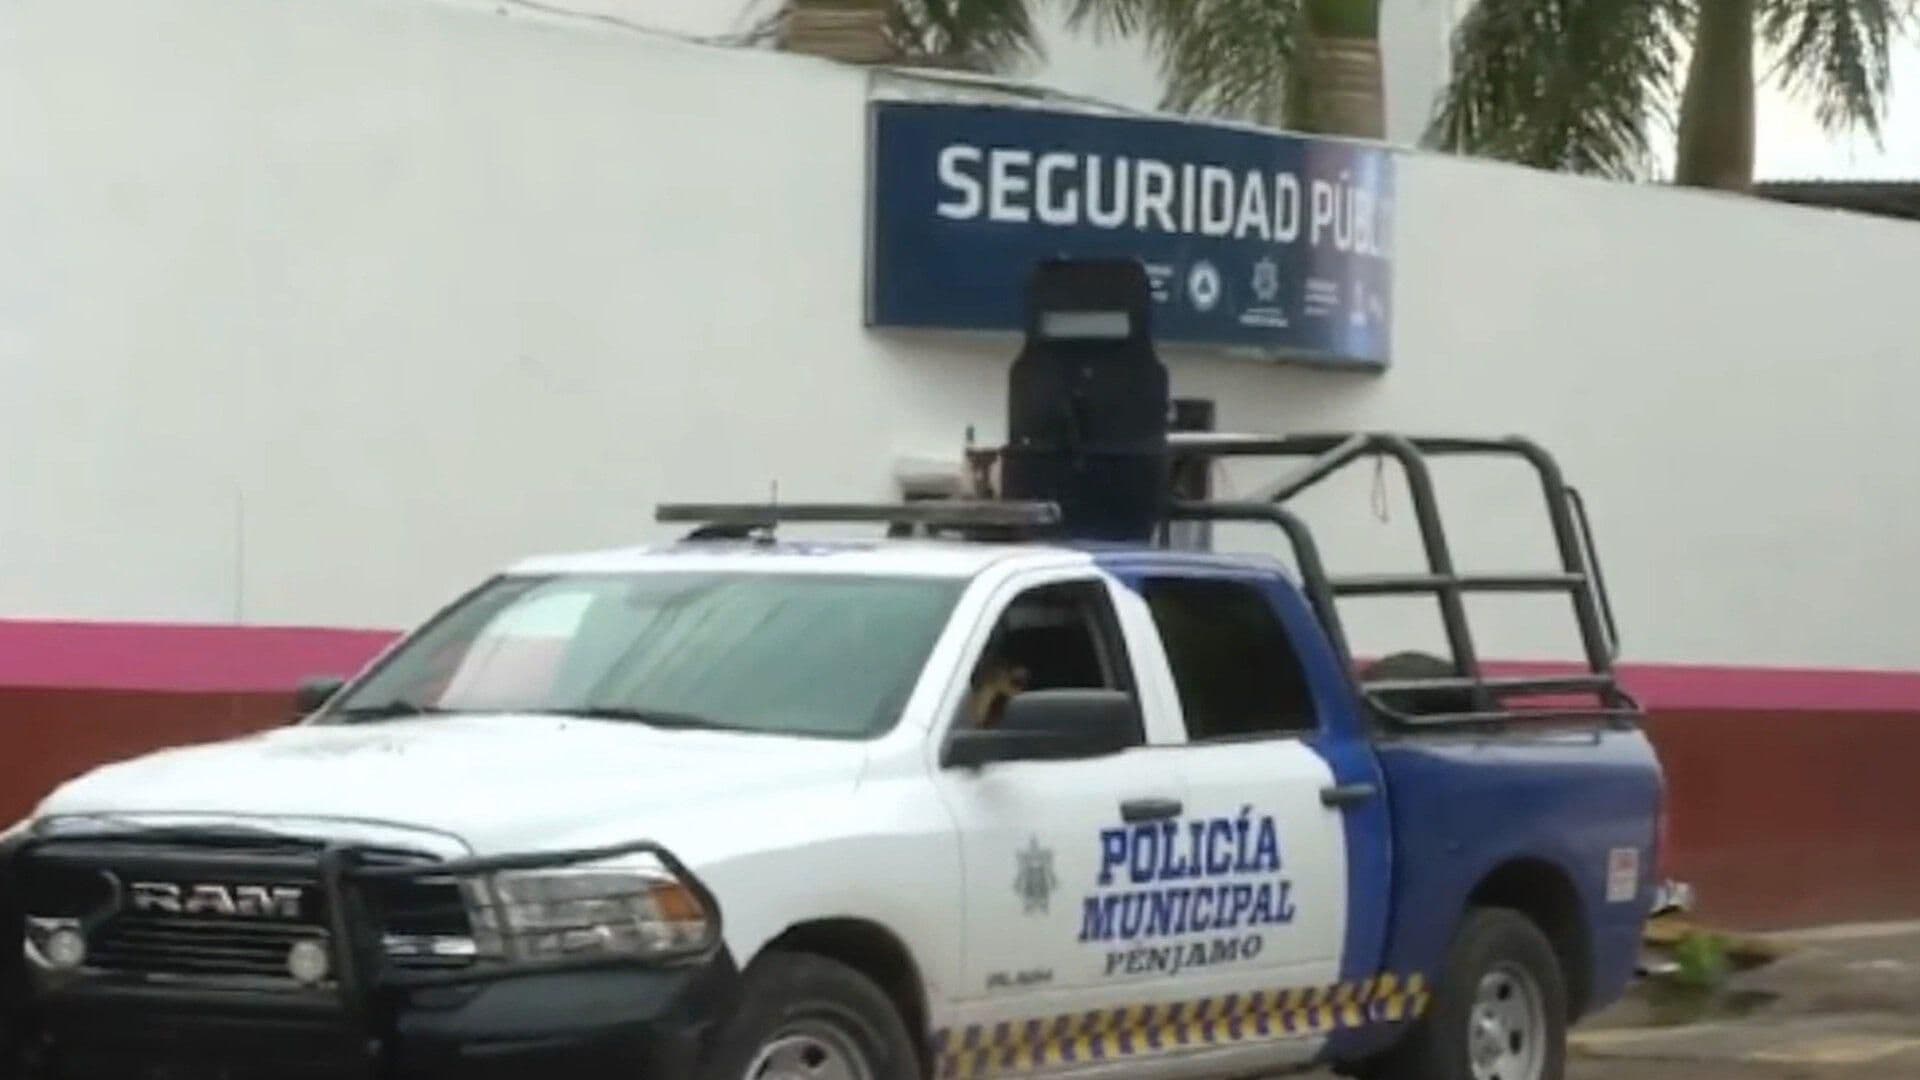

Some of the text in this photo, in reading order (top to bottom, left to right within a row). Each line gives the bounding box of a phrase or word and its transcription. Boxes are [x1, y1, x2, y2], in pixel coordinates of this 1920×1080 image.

[936, 145, 1299, 243] SEGURIDAD
[1098, 805, 1282, 886] POLICÍA
[132, 881, 302, 916] RAM
[1079, 880, 1295, 942] MUNICIPAL
